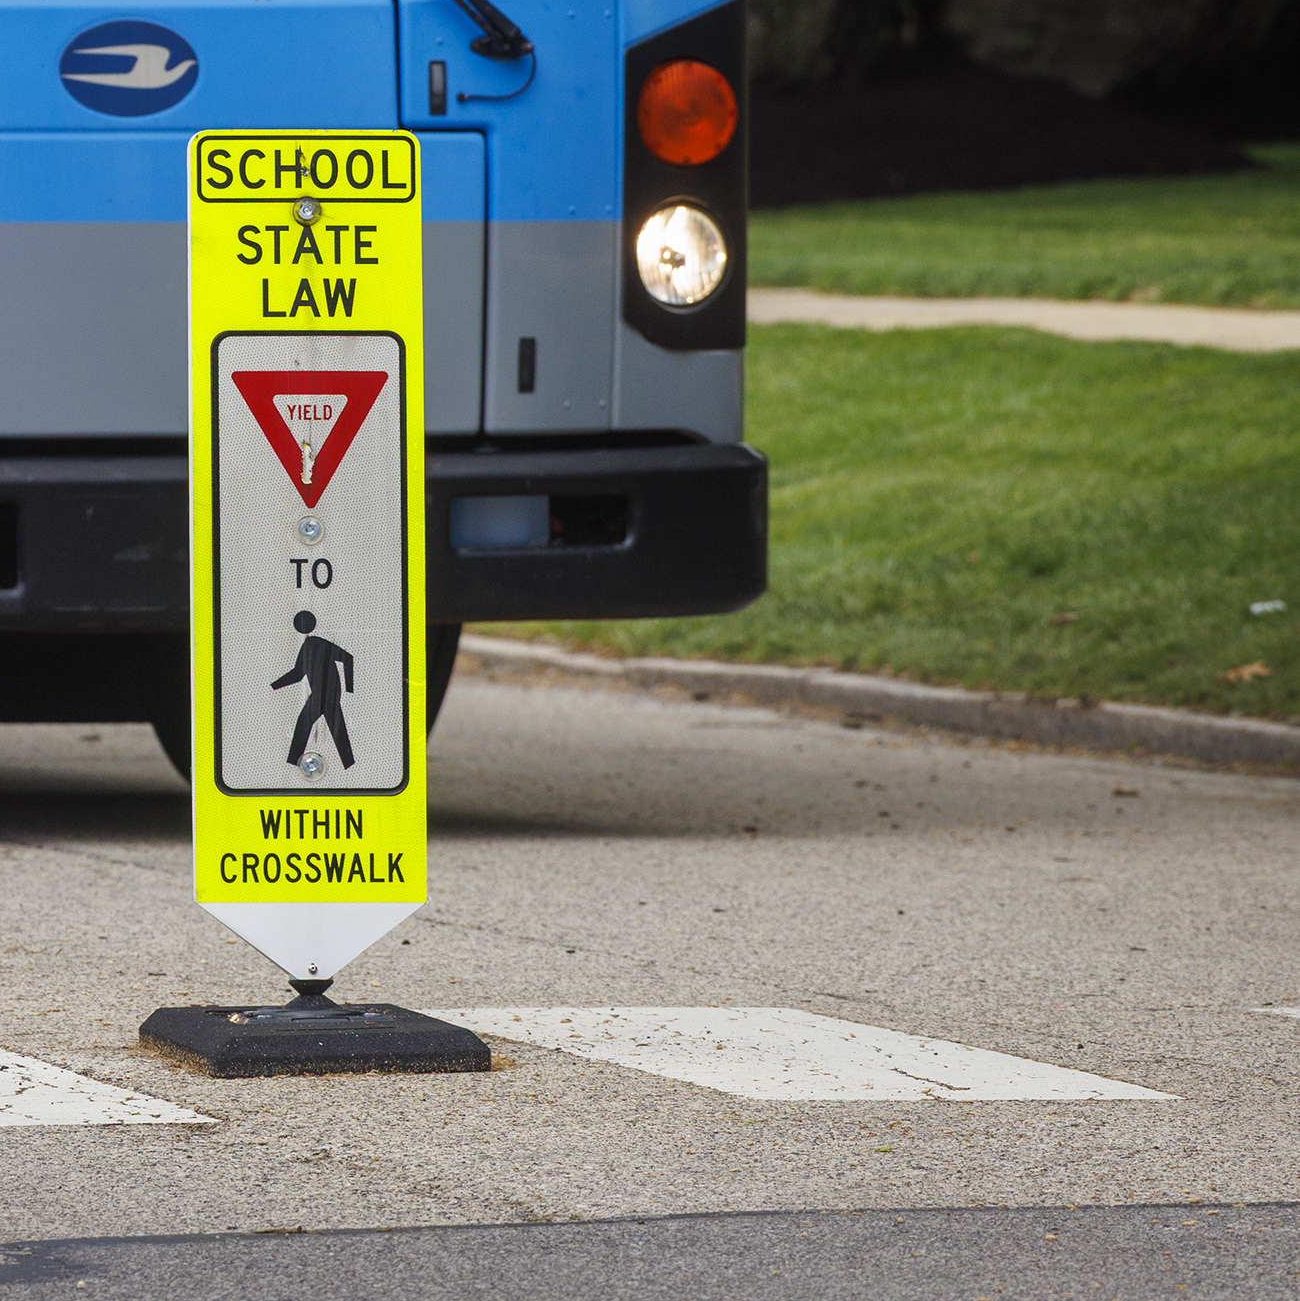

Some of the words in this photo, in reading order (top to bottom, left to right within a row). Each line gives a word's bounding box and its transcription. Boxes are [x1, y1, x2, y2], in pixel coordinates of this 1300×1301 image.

[205, 148, 408, 190] SCHOOL
[236, 225, 379, 265] STATE
[261, 278, 357, 318] LAW
[286, 404, 333, 421] YIELD
[289, 558, 333, 590] TO
[259, 809, 363, 840] WITHIN
[219, 852, 405, 884] CROSSWALK
